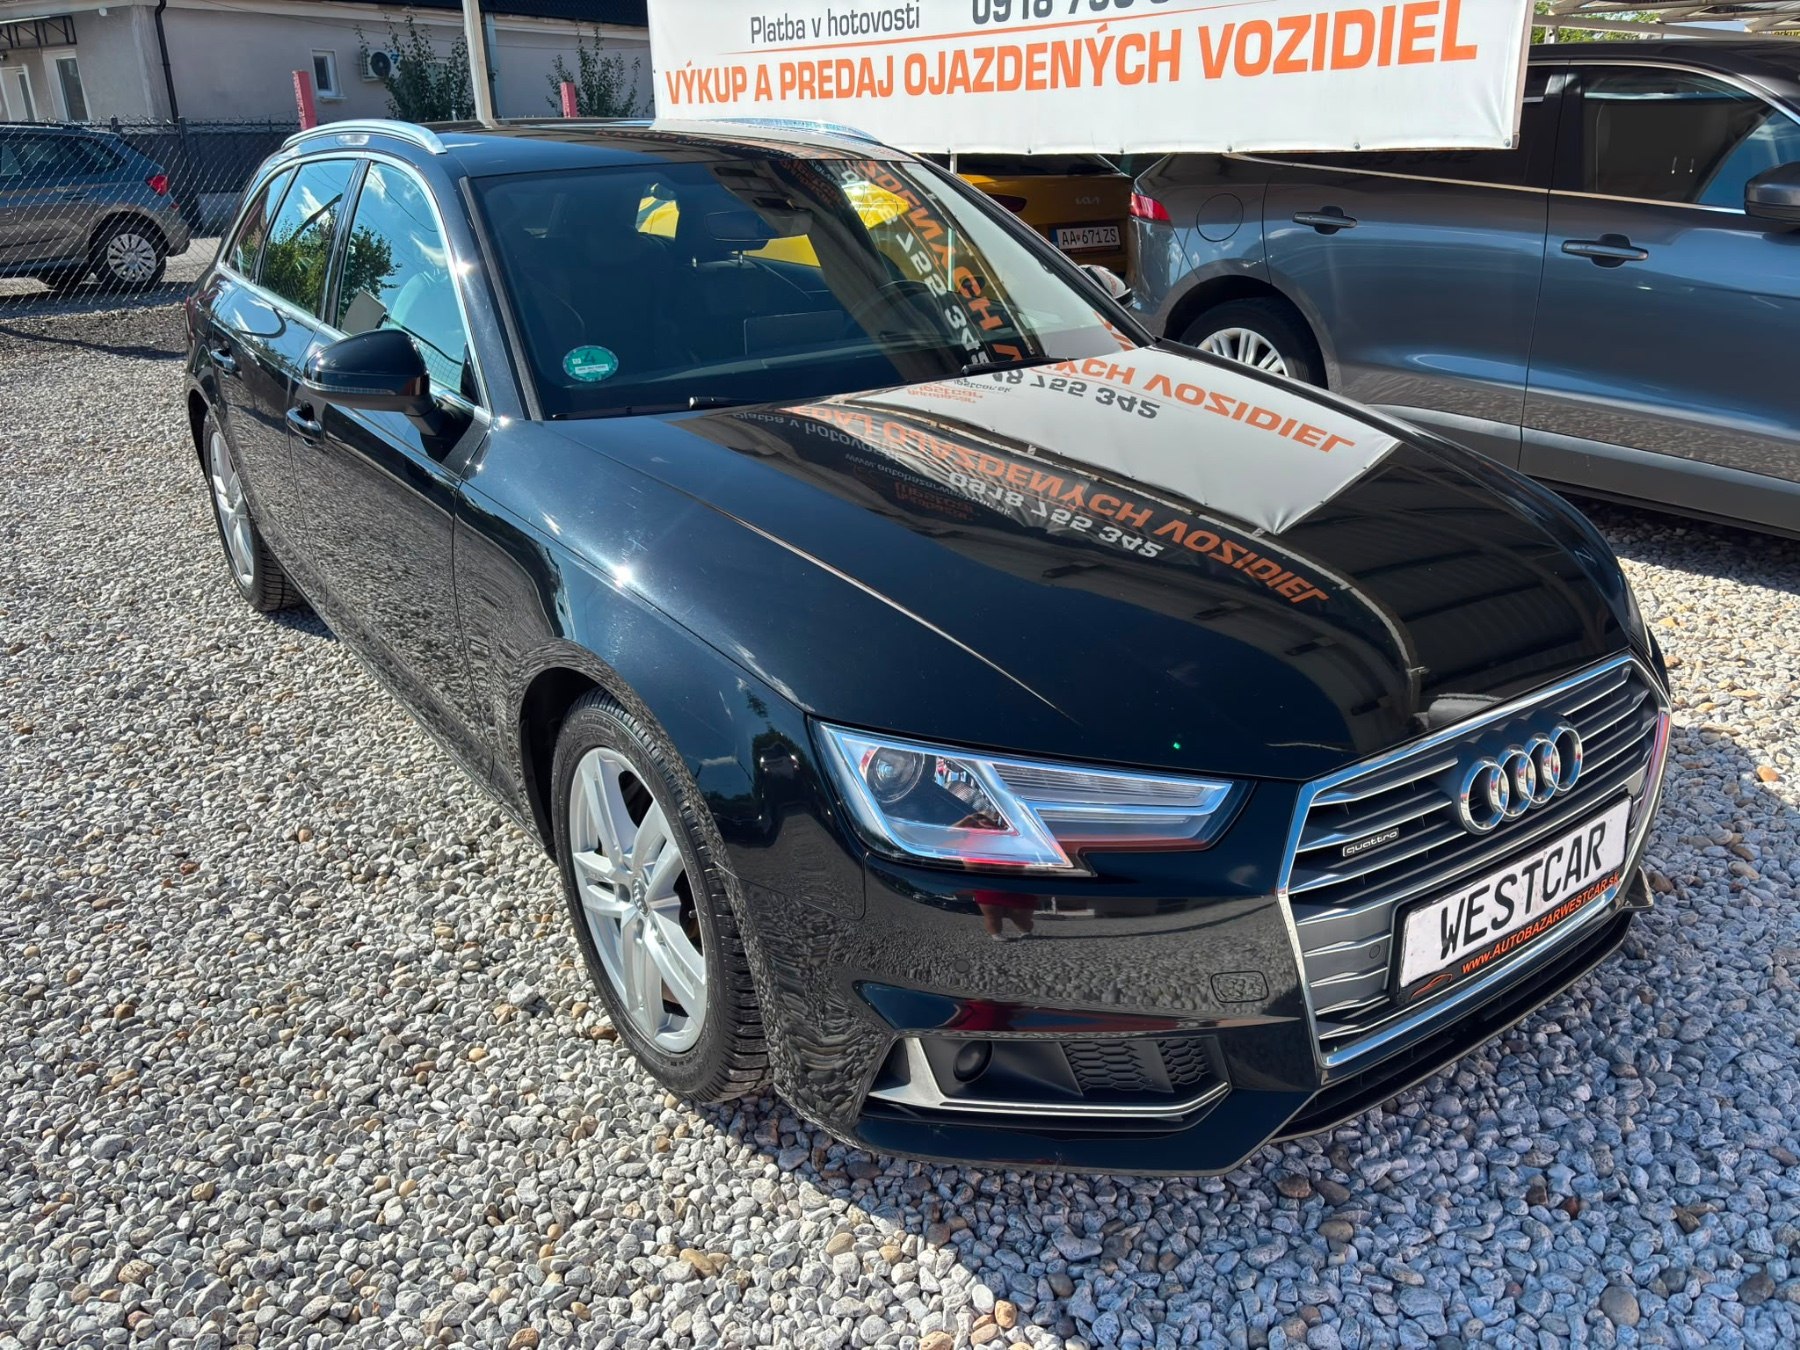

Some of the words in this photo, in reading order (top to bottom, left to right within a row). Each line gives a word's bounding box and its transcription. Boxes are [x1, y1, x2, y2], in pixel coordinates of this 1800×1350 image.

[665, 60, 747, 105] VÝKUP
[754, 64, 773, 102] A
[779, 55, 894, 100] PREDAJ
[904, 22, 1182, 96] OJAZDENÝCH
[1198, 0, 1478, 80] VOZIDIEL
[751, 13, 806, 44] Platba
[811, 20, 821, 38] v
[827, 1, 920, 36] hotovosti
[1082, 228, 1117, 244] 671ZS
[1346, 830, 1398, 854] quattro
[1440, 820, 1606, 961] WESTCAR
[1461, 870, 1620, 975] www.AUTOBAZARWESTCAR.sk
